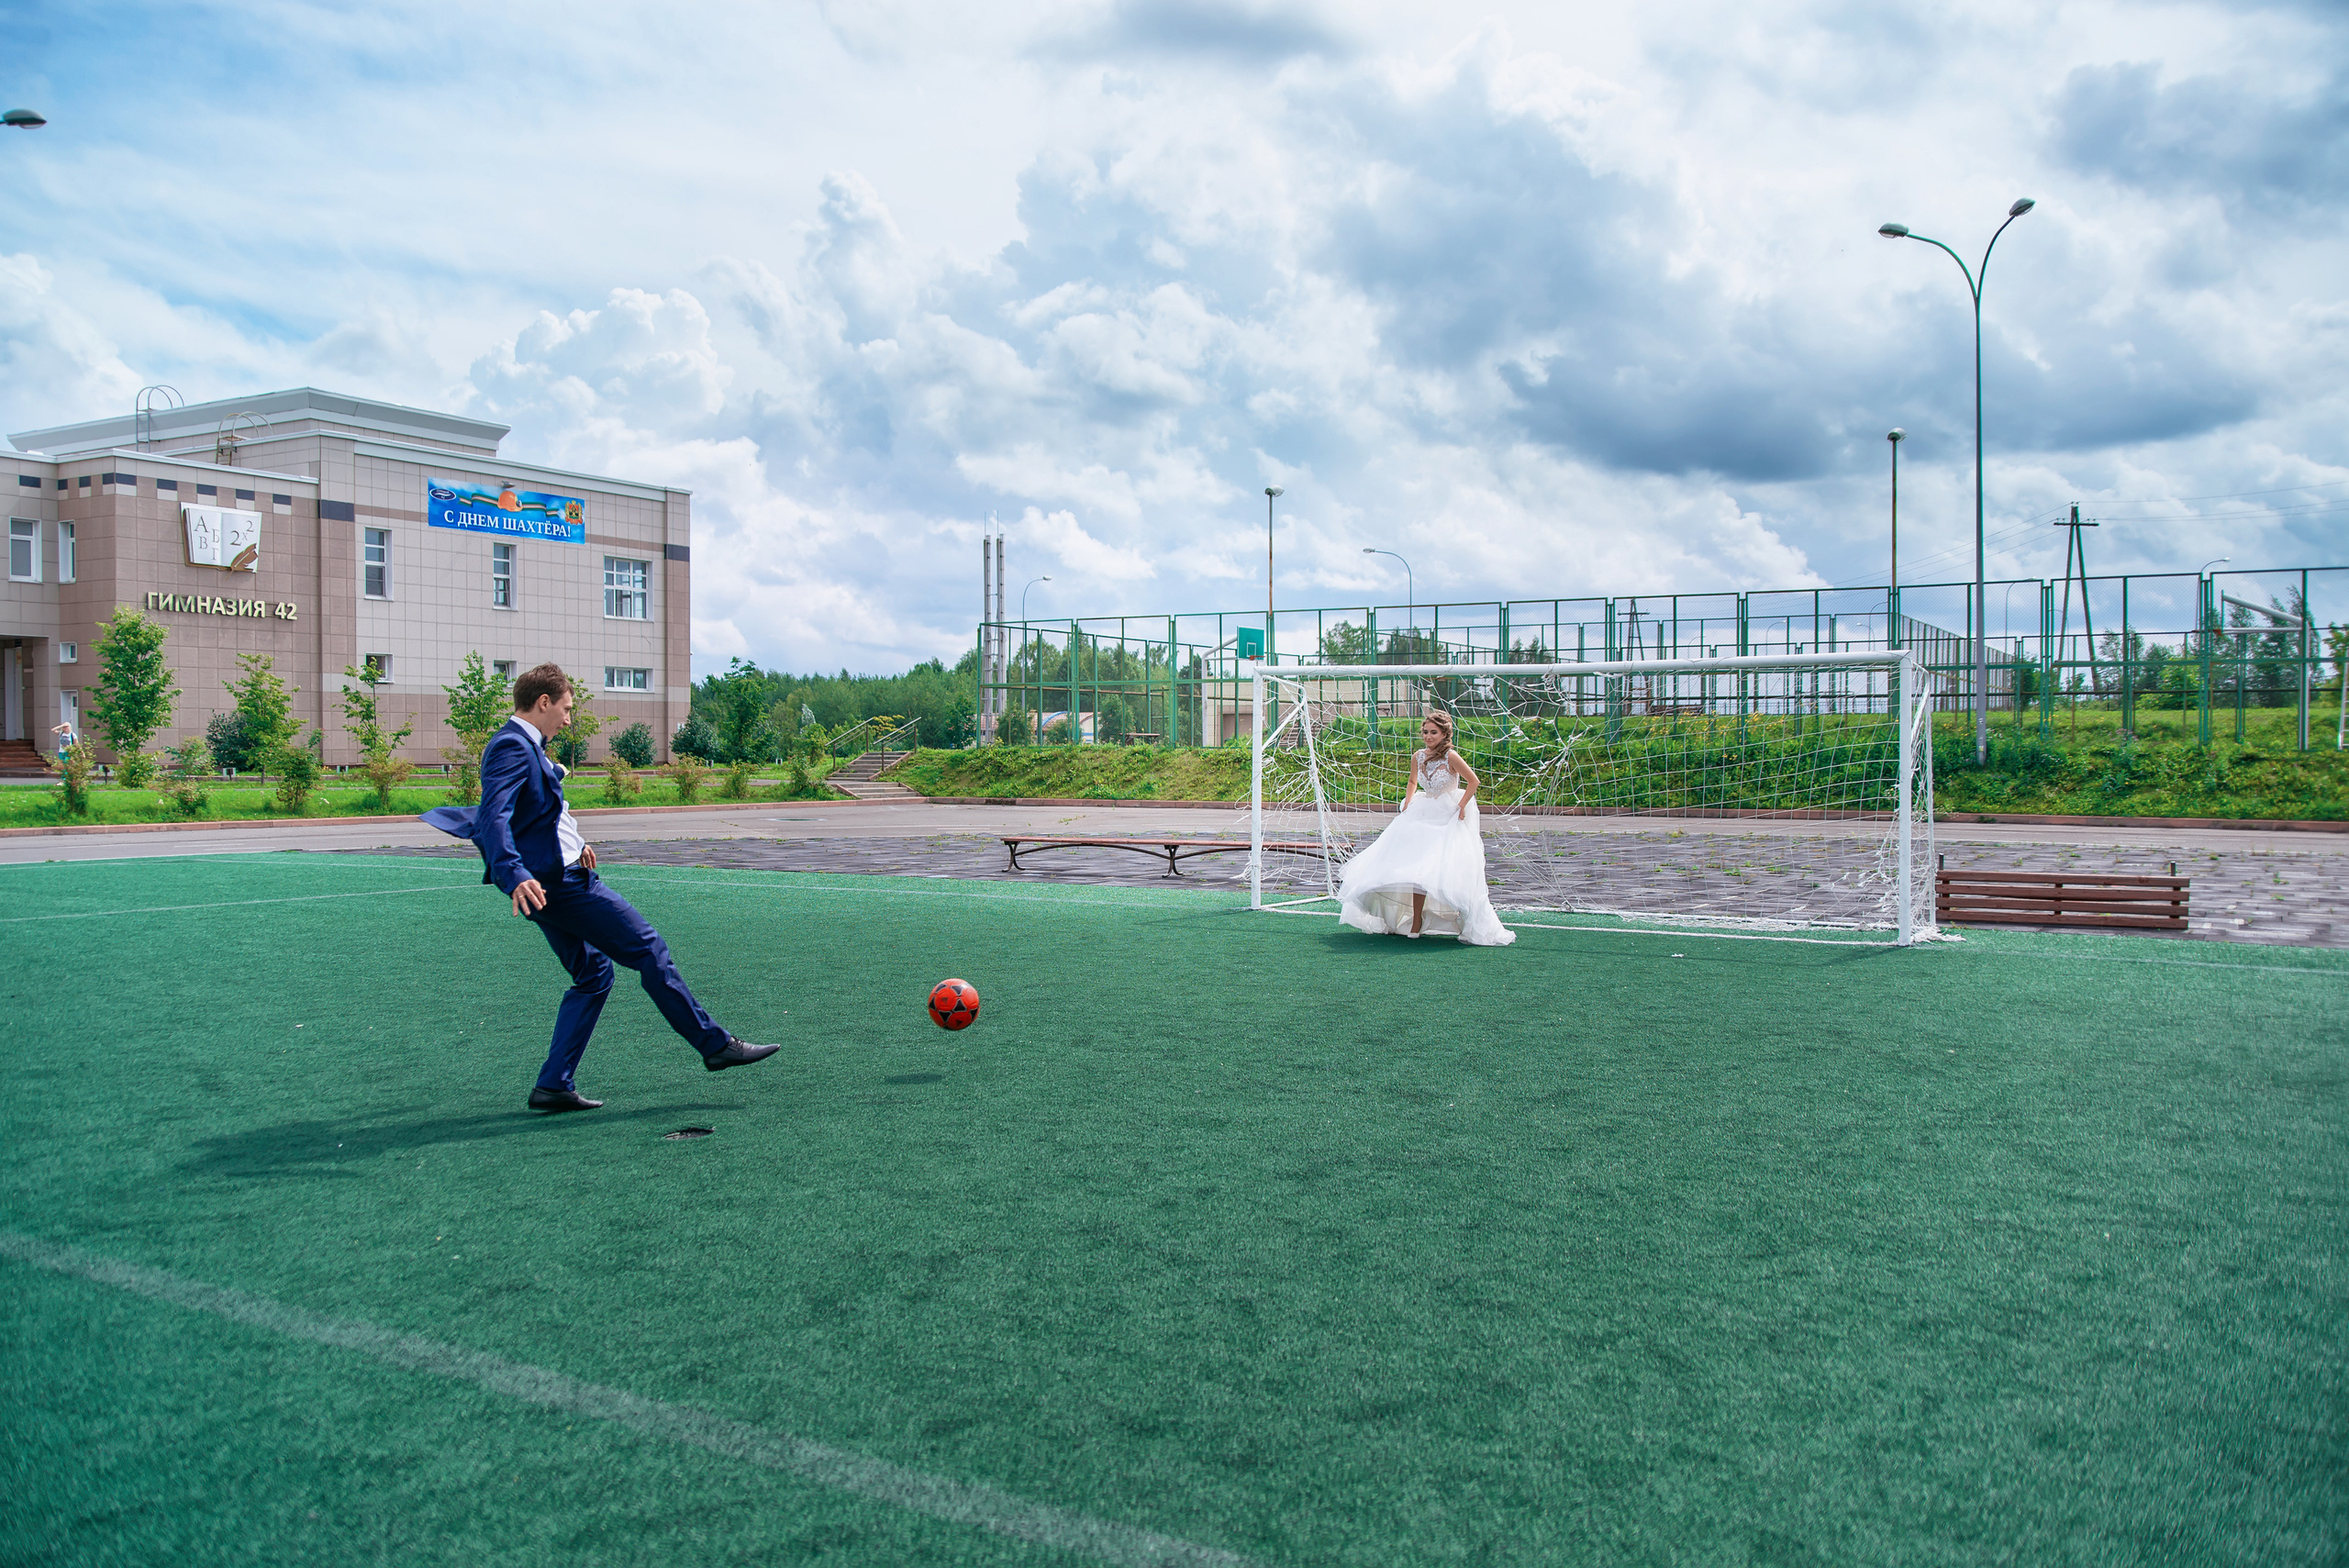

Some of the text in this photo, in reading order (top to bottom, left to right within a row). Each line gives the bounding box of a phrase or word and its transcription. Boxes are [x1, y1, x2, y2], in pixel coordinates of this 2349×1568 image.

[229, 530, 242, 547] 2
[245, 519, 255, 533] 2
[444, 510, 572, 538] С ДНЕМ ШАХТЁРА!
[147, 591, 298, 620] ГИМНАЗИЯ 42
